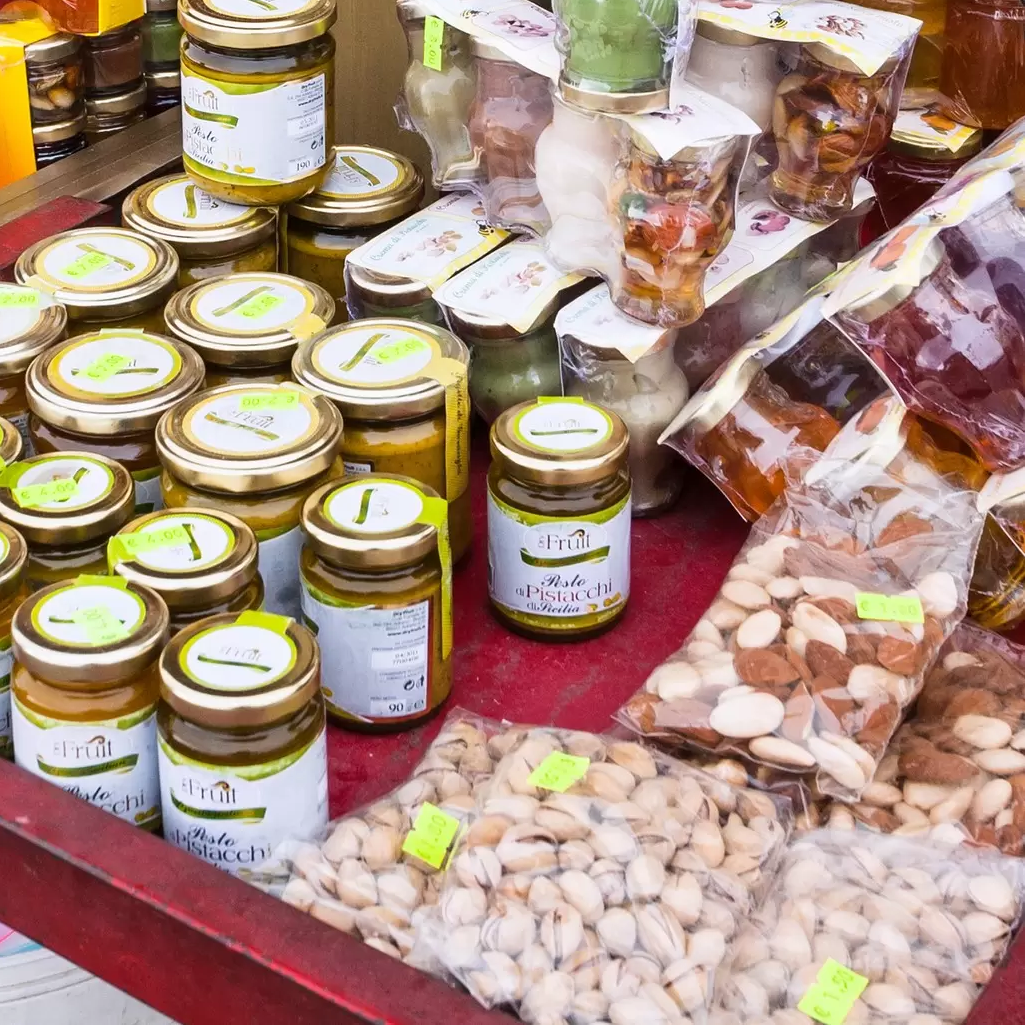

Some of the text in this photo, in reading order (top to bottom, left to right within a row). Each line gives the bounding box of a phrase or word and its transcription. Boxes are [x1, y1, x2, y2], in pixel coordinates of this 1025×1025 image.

[190, 89, 220, 111] Fruit
[191, 122, 218, 144] Pesto
[295, 160, 312, 172] 190
[547, 529, 591, 551] Fruit
[515, 578, 613, 603] di Pistacchi
[541, 573, 588, 588] Pesto
[526, 601, 580, 613] di Sicilia
[388, 702, 404, 712] 90
[62, 734, 112, 760] Fruit
[188, 779, 237, 804] Fruit
[189, 823, 235, 847] Pesto
